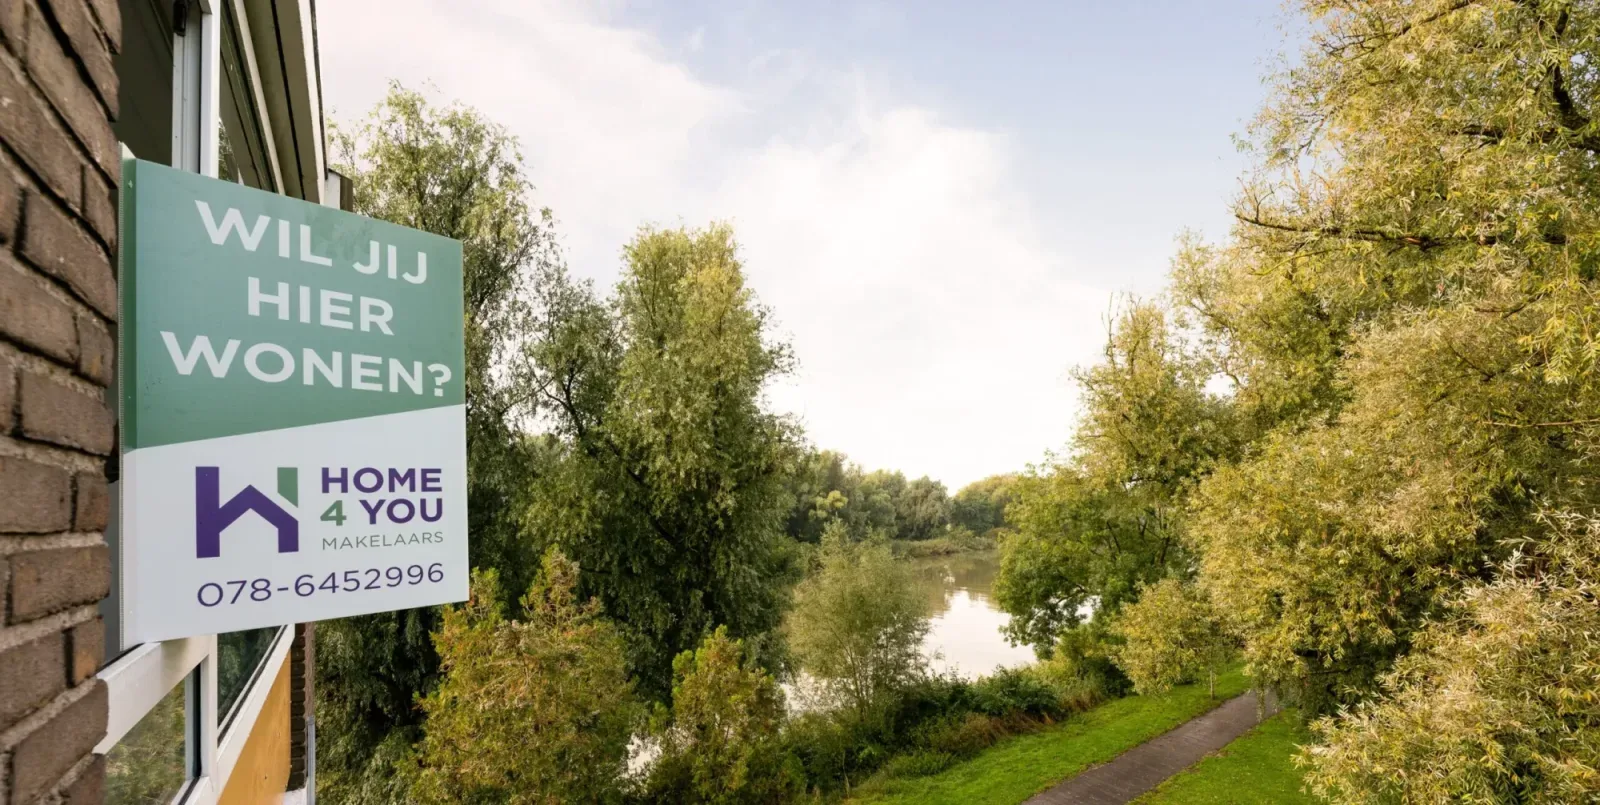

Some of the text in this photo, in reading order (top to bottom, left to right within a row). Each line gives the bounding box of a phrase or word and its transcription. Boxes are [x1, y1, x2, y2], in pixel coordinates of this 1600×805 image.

[195, 200, 428, 285] WIL JIJ
[248, 276, 394, 335] HIER
[160, 331, 453, 397] WONEN?
[321, 467, 443, 494] HOME
[320, 497, 444, 526] 4 YOU
[321, 531, 444, 551] MAKELAARS
[197, 562, 445, 608] 078-6452996
